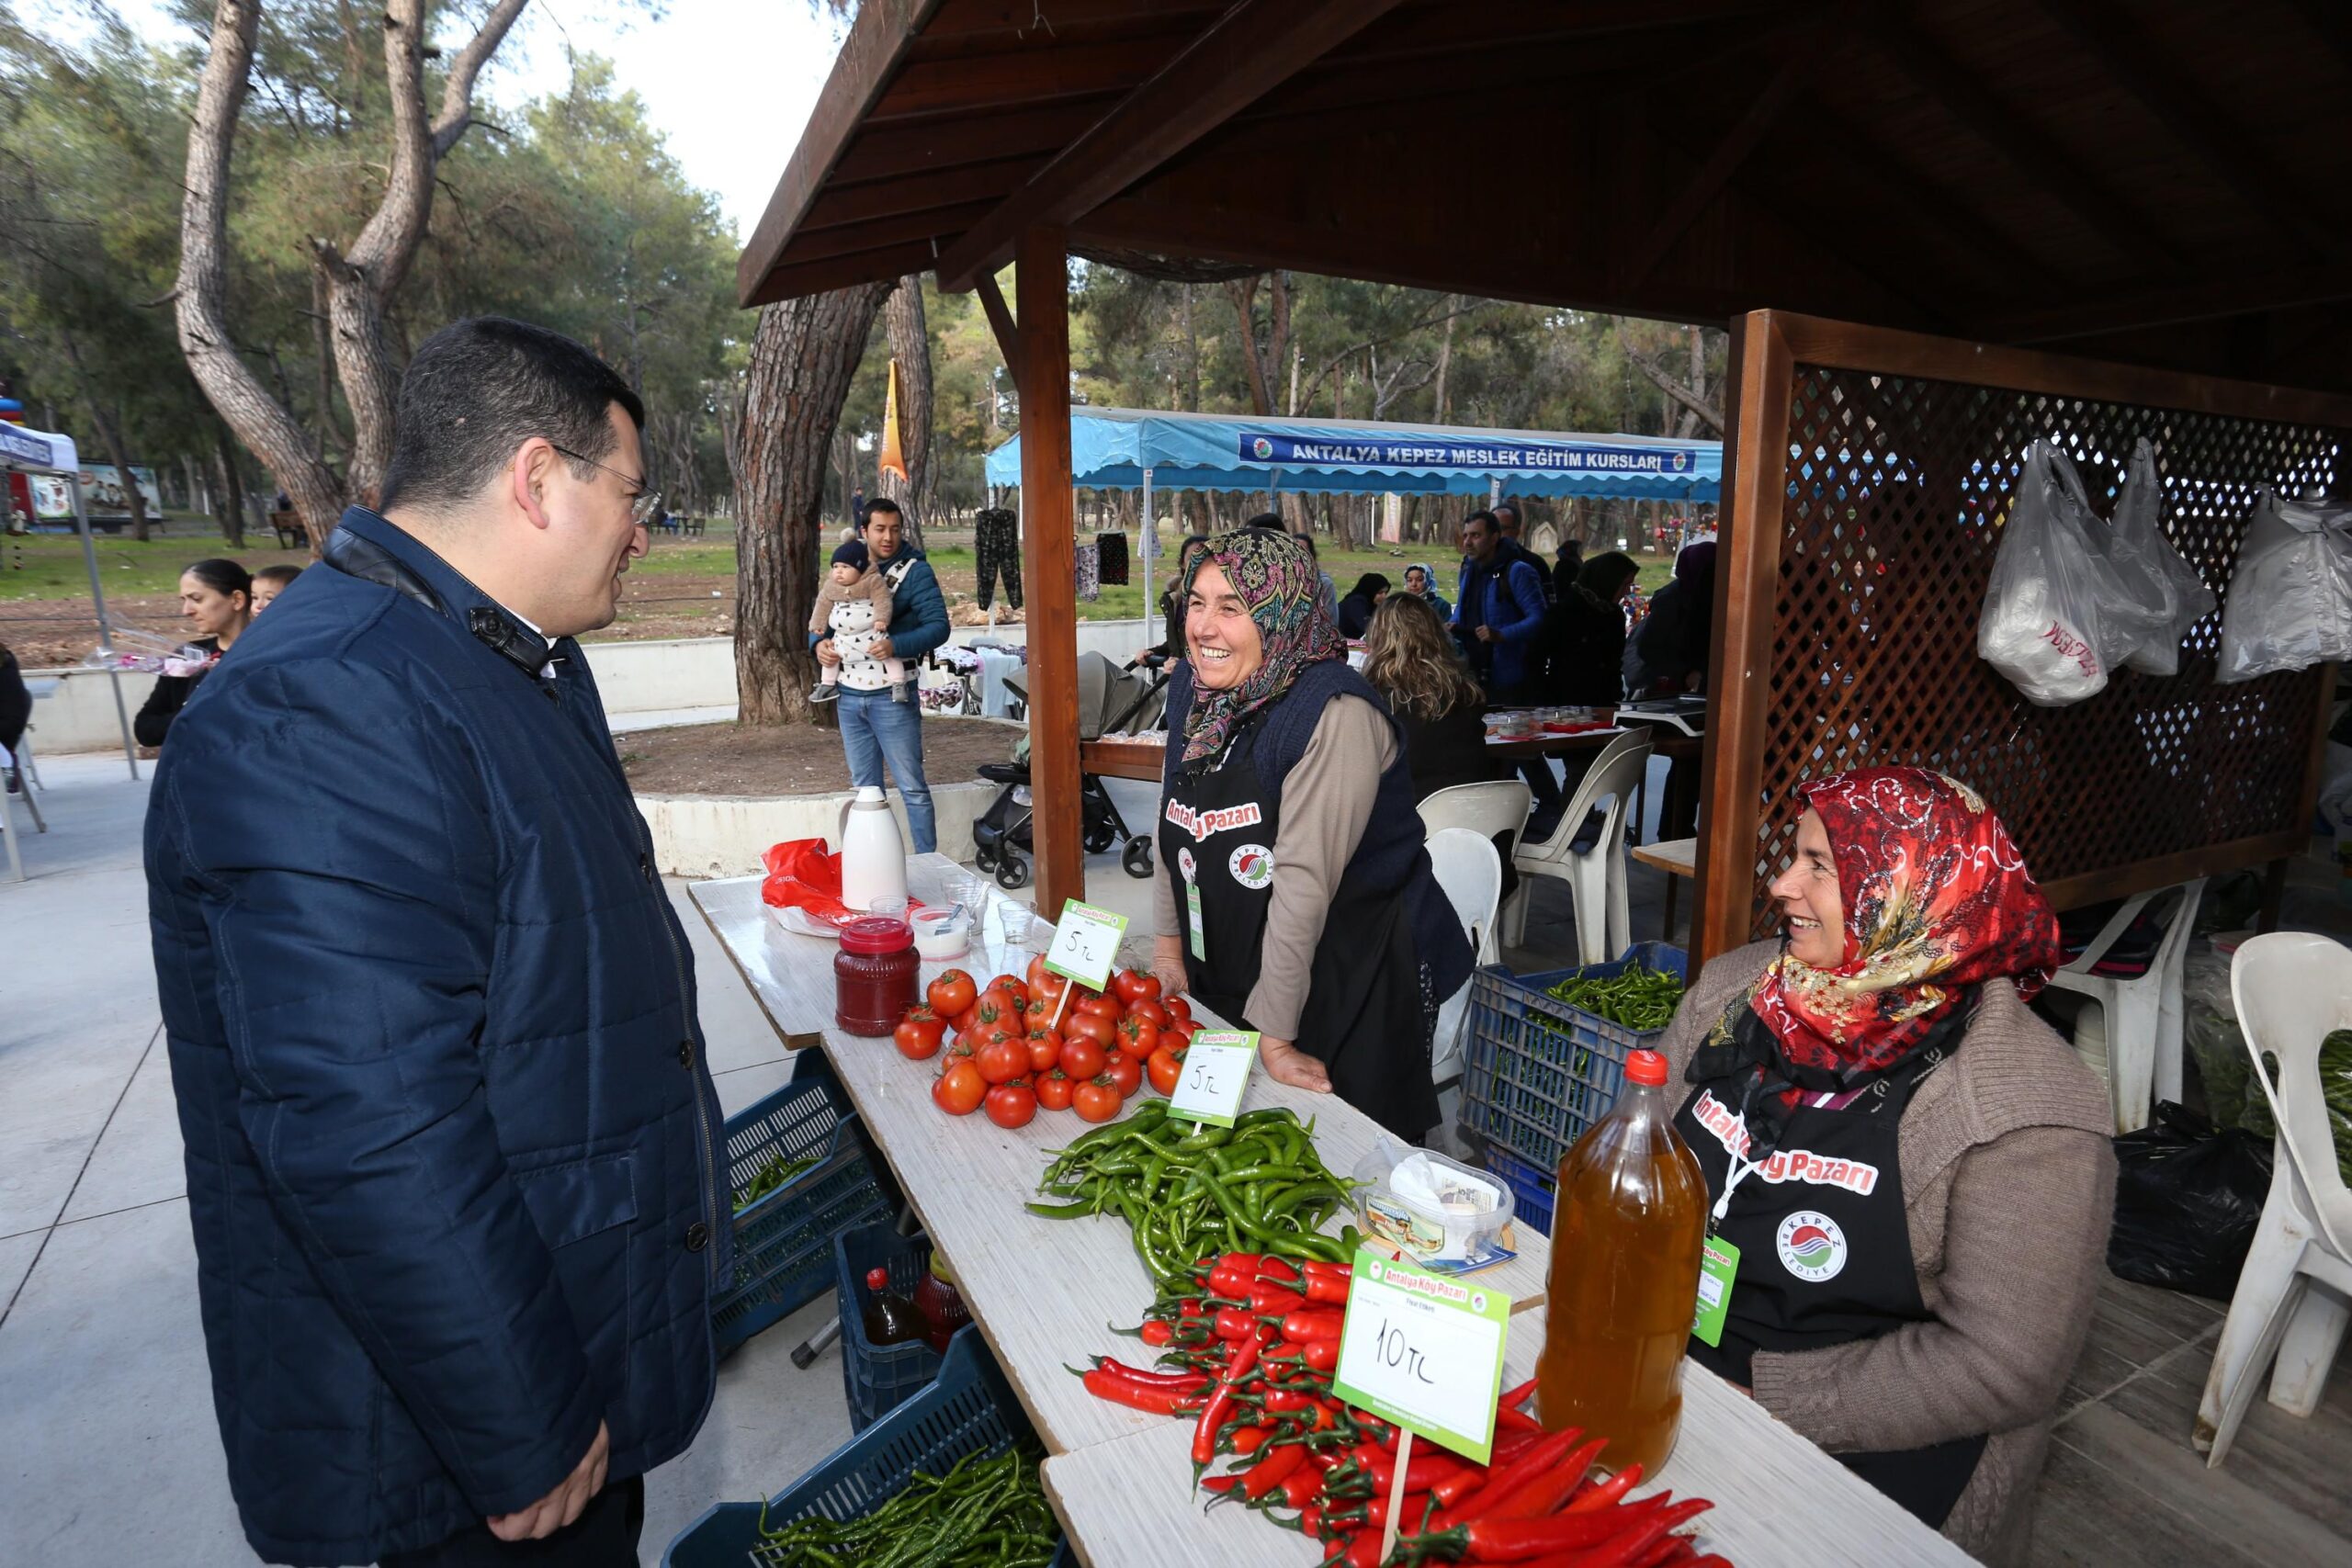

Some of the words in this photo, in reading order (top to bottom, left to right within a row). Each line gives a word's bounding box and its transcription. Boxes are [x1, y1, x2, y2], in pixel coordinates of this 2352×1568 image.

[1292, 444, 1380, 462] ANTALYA
[1386, 447, 1447, 463] KEPEZ
[1452, 449, 1521, 465] MESLEK
[1525, 448, 1582, 467] EĞİTİM
[1587, 454, 1662, 473] KURSLARI
[1204, 806, 1259, 833] Pazarı
[1234, 848, 1268, 864] KEPEZ
[1066, 931, 1082, 953] 5
[1190, 1065, 1207, 1090] 5
[1204, 1076, 1219, 1095] TL
[1790, 1153, 1873, 1191] Pazarı
[1788, 1215, 1842, 1248] KEPEZ
[1385, 1269, 1418, 1290] Antalya
[1438, 1282, 1466, 1301] Pazarı
[1377, 1317, 1406, 1368] 10
